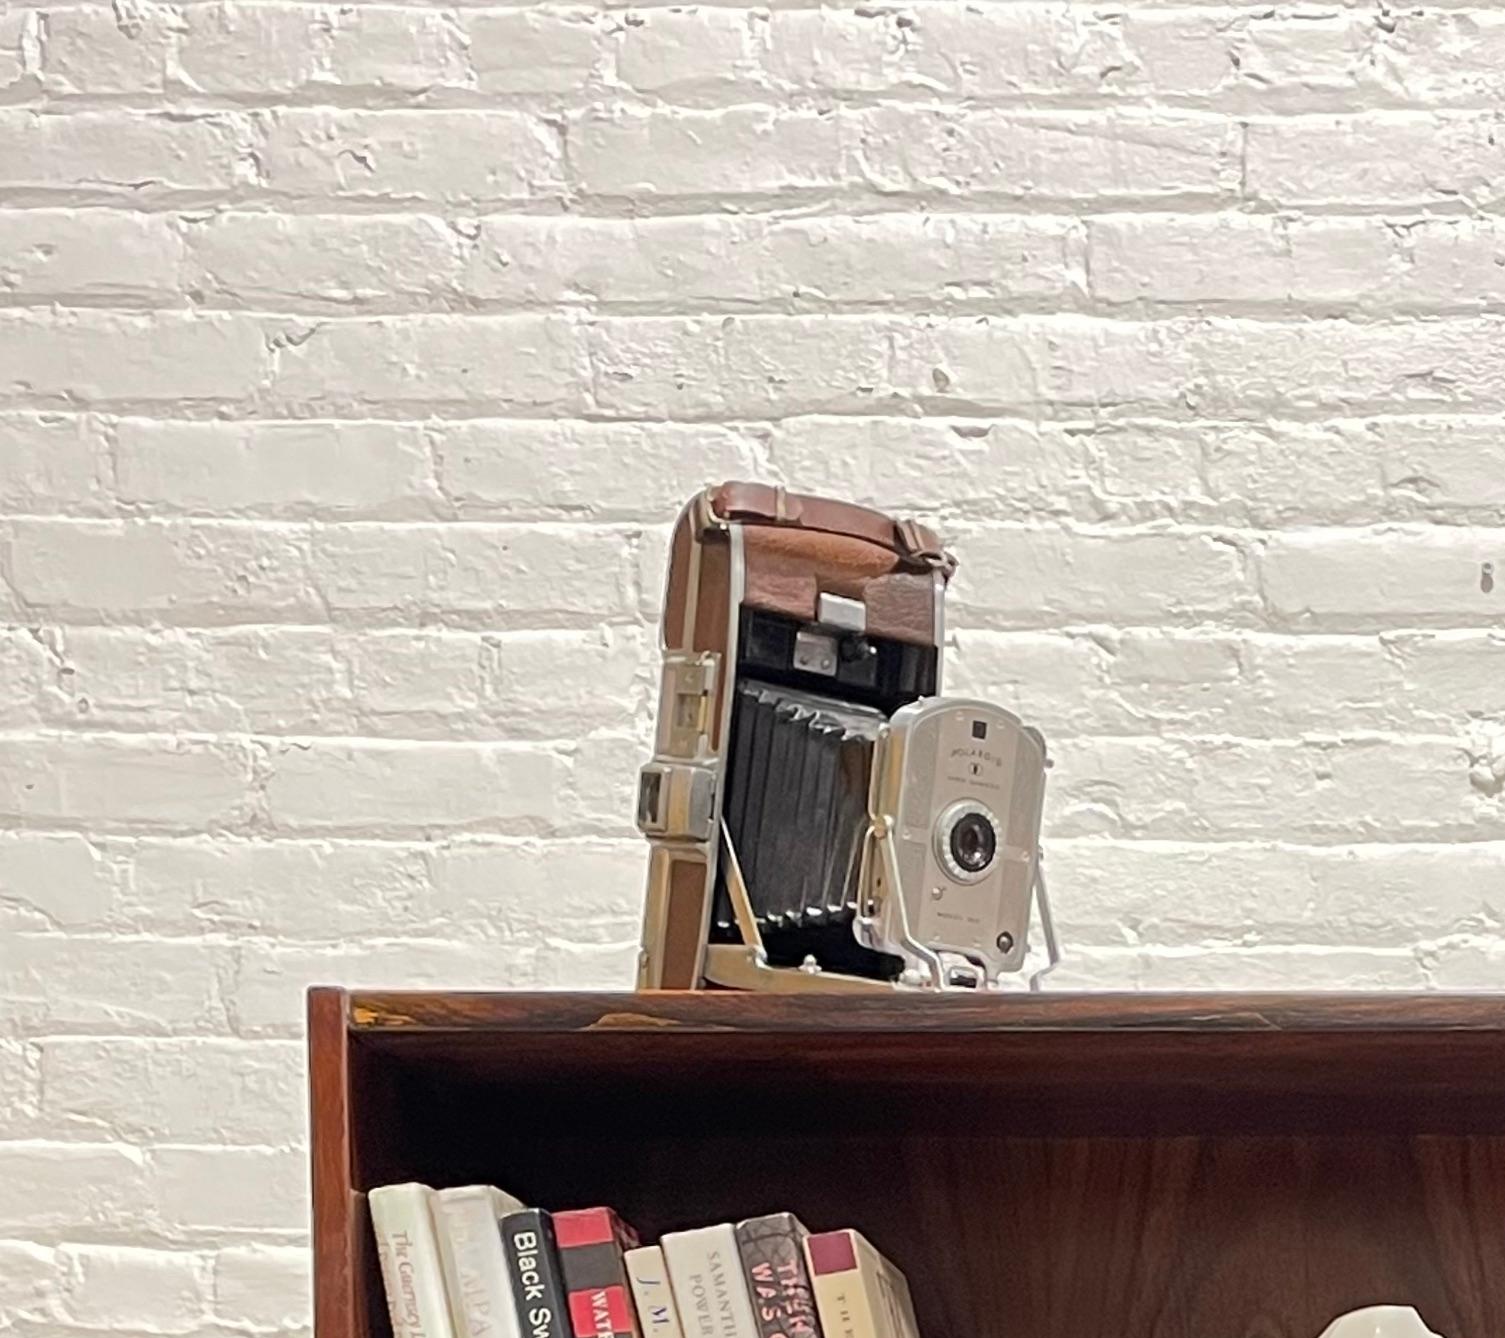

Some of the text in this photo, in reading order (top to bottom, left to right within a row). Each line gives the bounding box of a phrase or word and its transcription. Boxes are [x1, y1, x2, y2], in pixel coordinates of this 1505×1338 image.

[391, 1229, 413, 1255] The
[514, 1231, 542, 1300] Black
[398, 1260, 421, 1332] Guernsey
[636, 1276, 660, 1296] J.
[651, 1306, 669, 1333] M.
[690, 1274, 713, 1336] POWER
[752, 1262, 781, 1322] WAS
